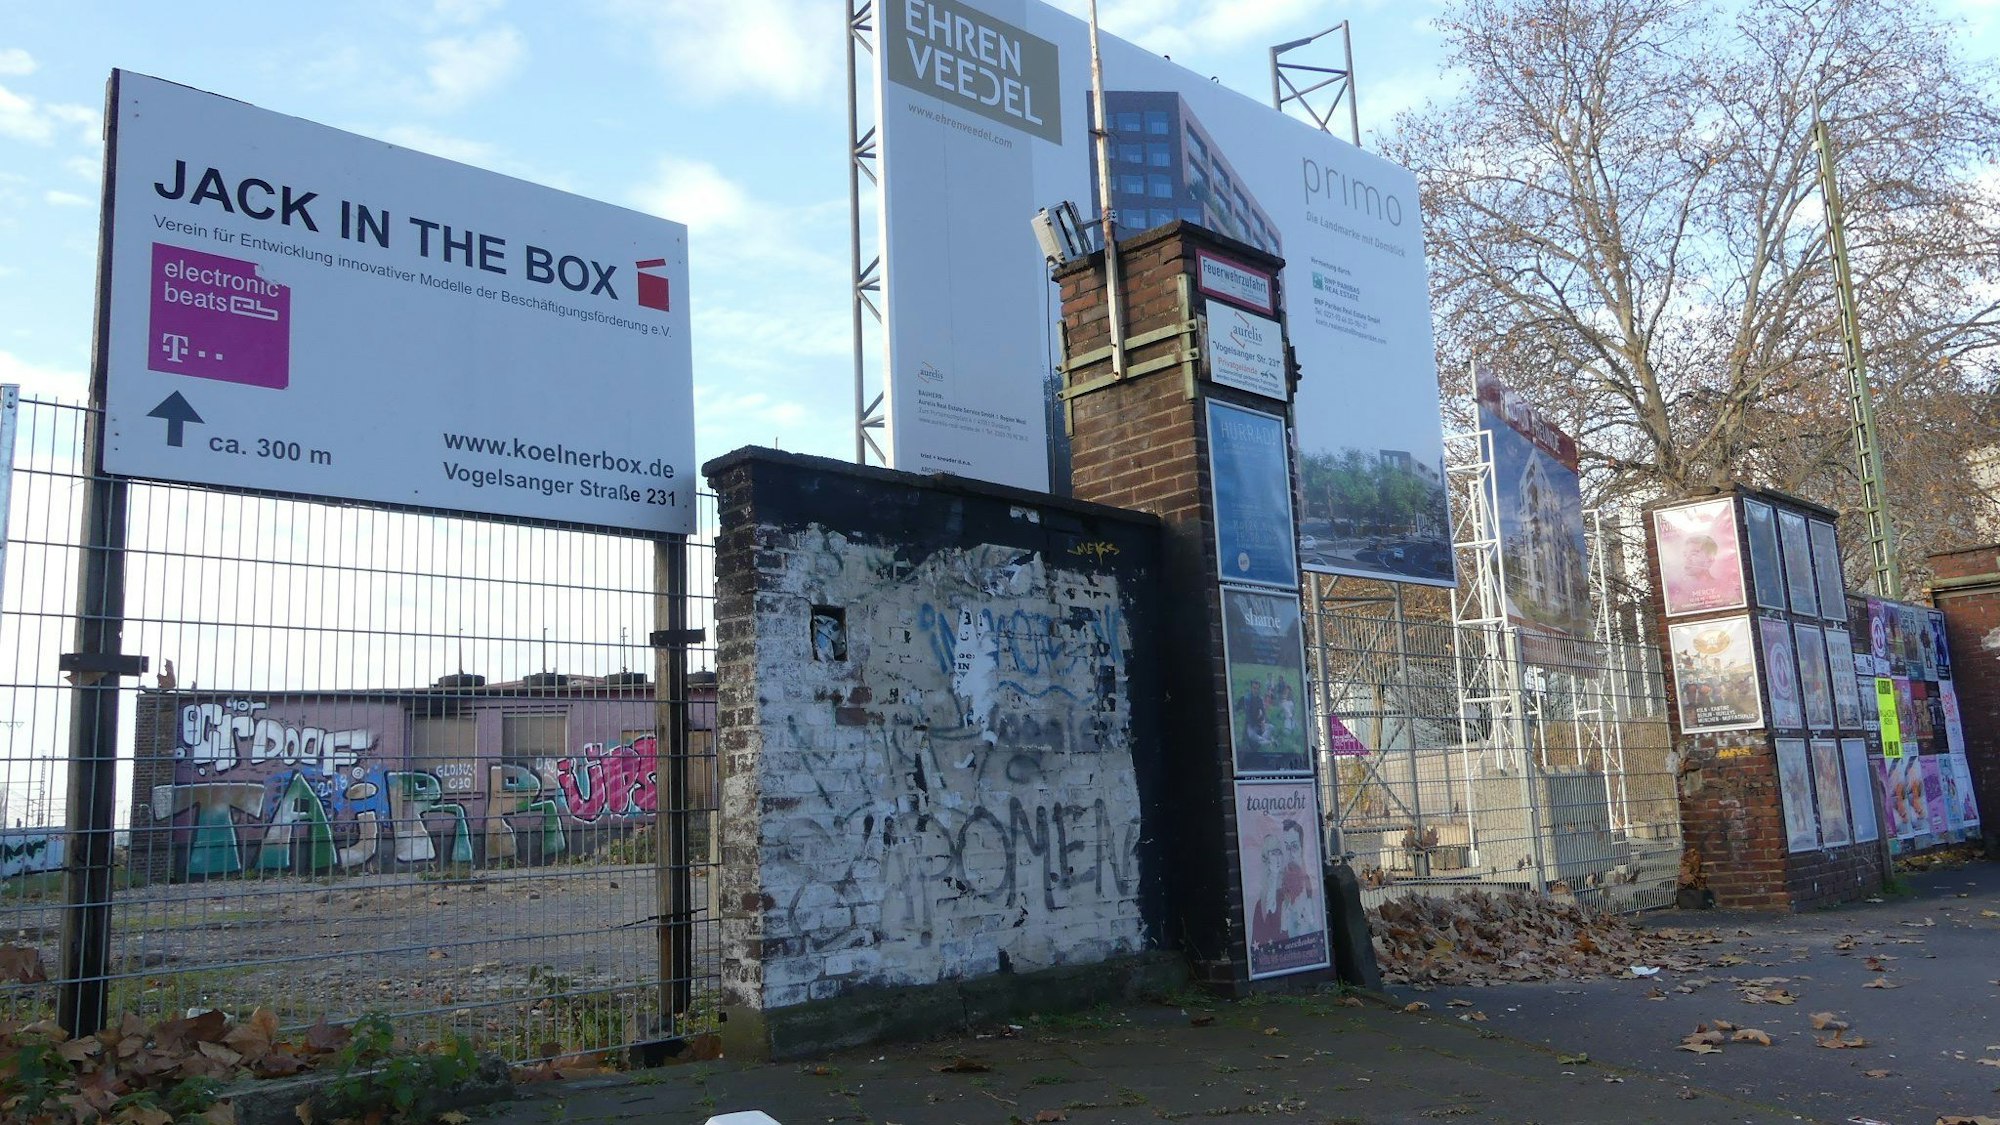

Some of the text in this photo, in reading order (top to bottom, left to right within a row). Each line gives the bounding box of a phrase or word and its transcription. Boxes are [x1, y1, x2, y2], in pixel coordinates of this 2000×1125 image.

[905, 0, 1021, 77] EHREN
[908, 104, 1013, 149] www.ehrenveedel.com
[1303, 157, 1402, 227] primo
[154, 160, 619, 300] JACK IN THE BOX
[154, 214, 672, 338] Verein für Entwicklung innovativer Modelle der Beschäftigungsförderung e.V.
[164, 259, 280, 298] electronic
[164, 282, 227, 312] beats
[1202, 258, 1267, 294] Feuerwehrzufahrt
[1233, 323, 1263, 341] aurelis
[209, 436, 332, 465] ca. 300 m
[443, 433, 675, 479] www.koelnerbox.de
[443, 462, 676, 507] Vogelsanger Straße 231
[1245, 607, 1281, 629] shame
[1246, 790, 1307, 816] tagnacht
